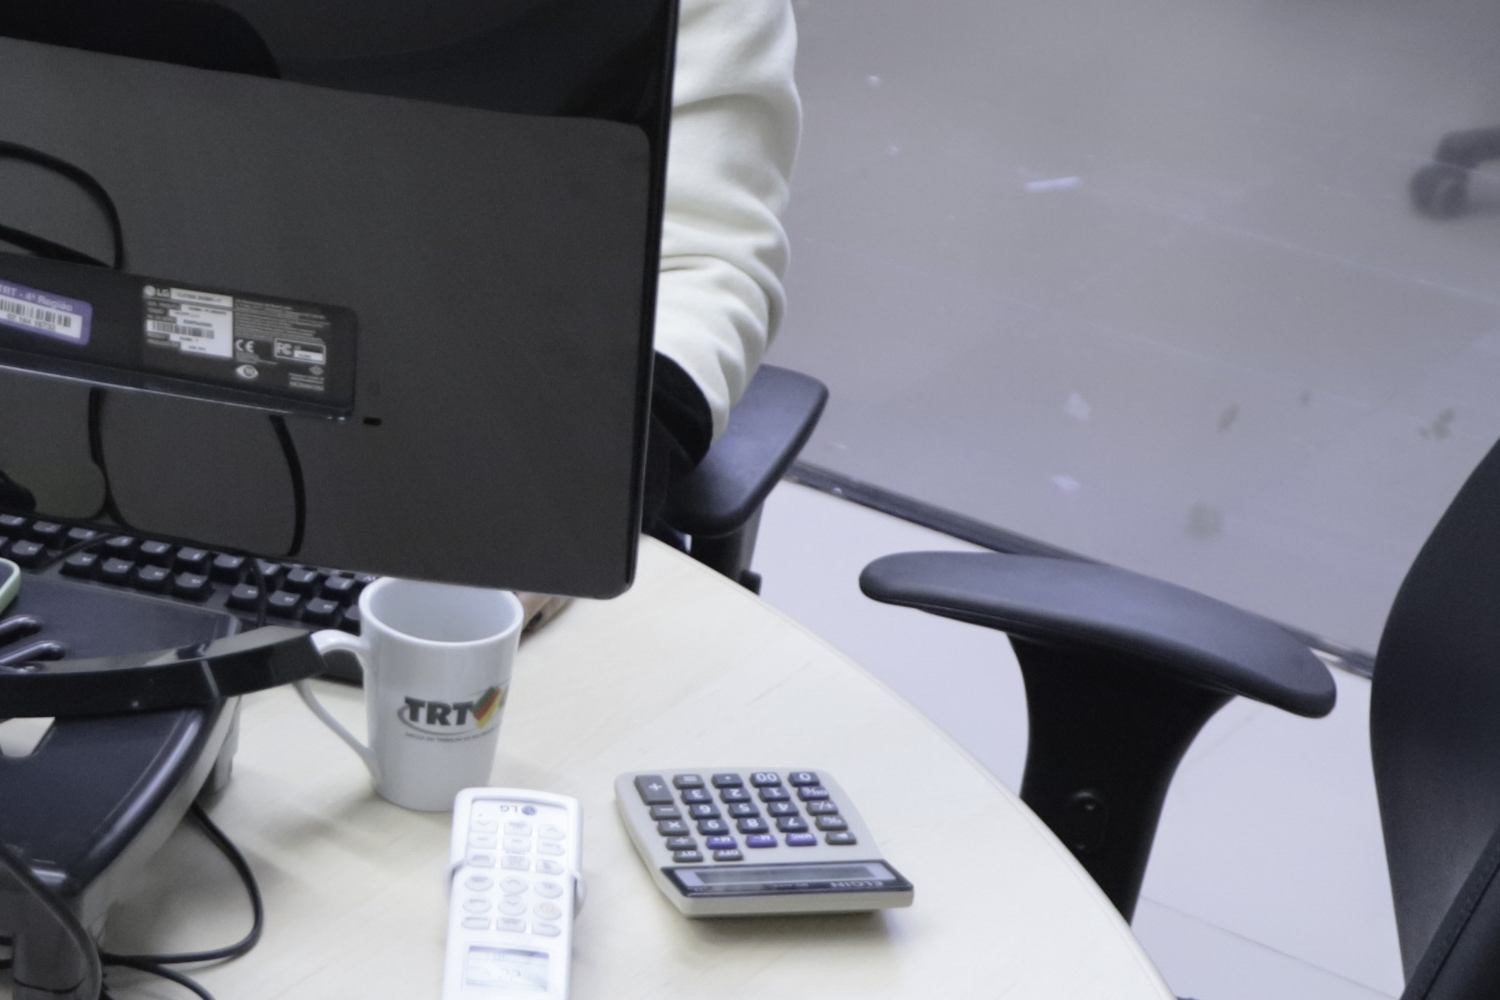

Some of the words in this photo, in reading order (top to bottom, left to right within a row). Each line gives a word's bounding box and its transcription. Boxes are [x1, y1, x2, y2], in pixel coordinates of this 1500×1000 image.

[405, 696, 474, 726] TRT
[499, 804, 519, 813] LG
[829, 880, 885, 889] ELGIN
